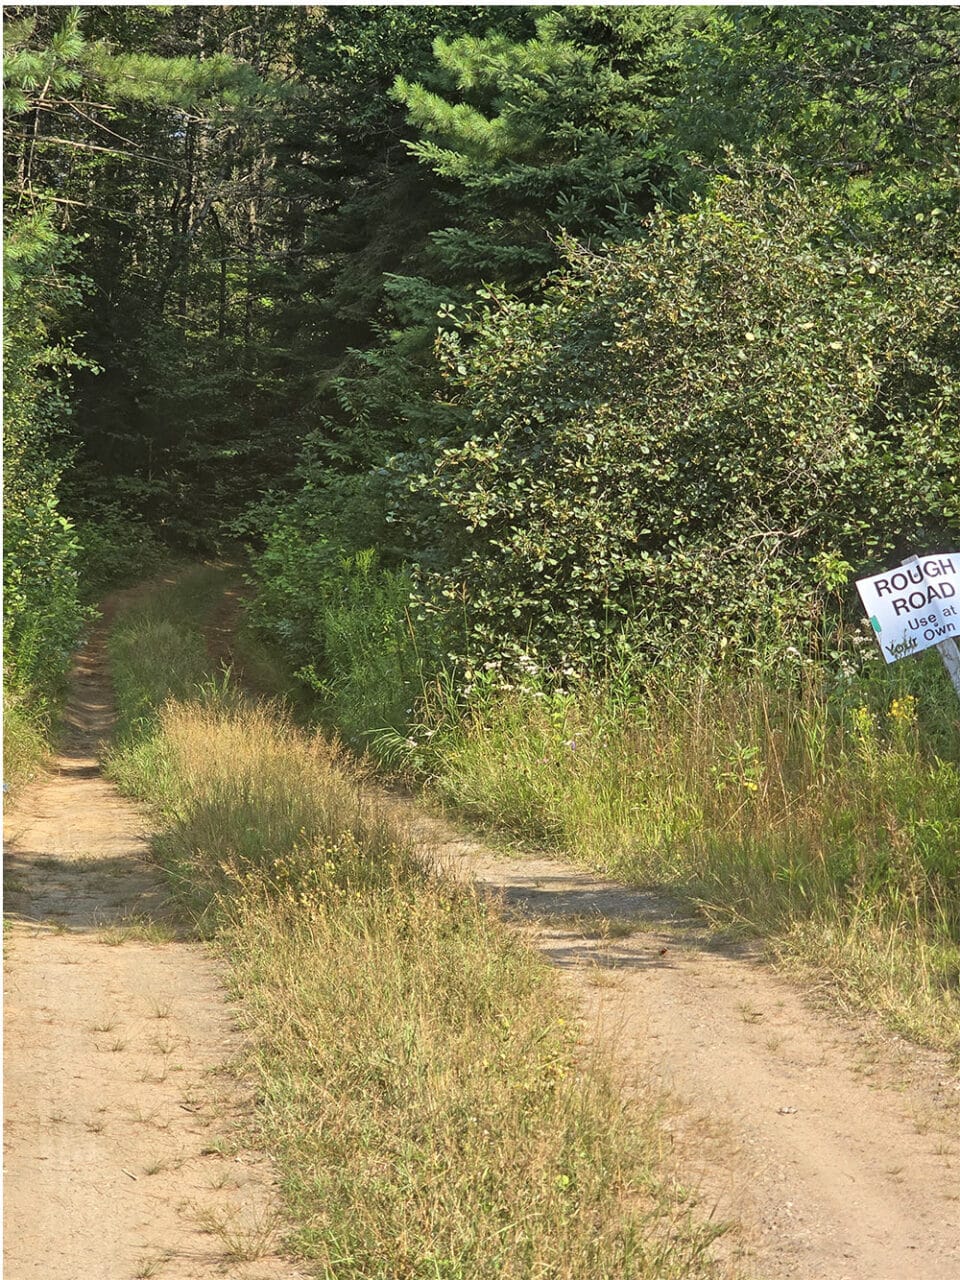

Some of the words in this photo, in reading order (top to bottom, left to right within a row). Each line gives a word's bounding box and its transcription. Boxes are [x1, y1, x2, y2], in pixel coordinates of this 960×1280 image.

[874, 558, 956, 597] ROUGH
[892, 582, 955, 616] ROAD
[908, 614, 936, 630] Use
[942, 605, 957, 617] at
[885, 637, 918, 656] Your
[924, 622, 956, 641] Own
